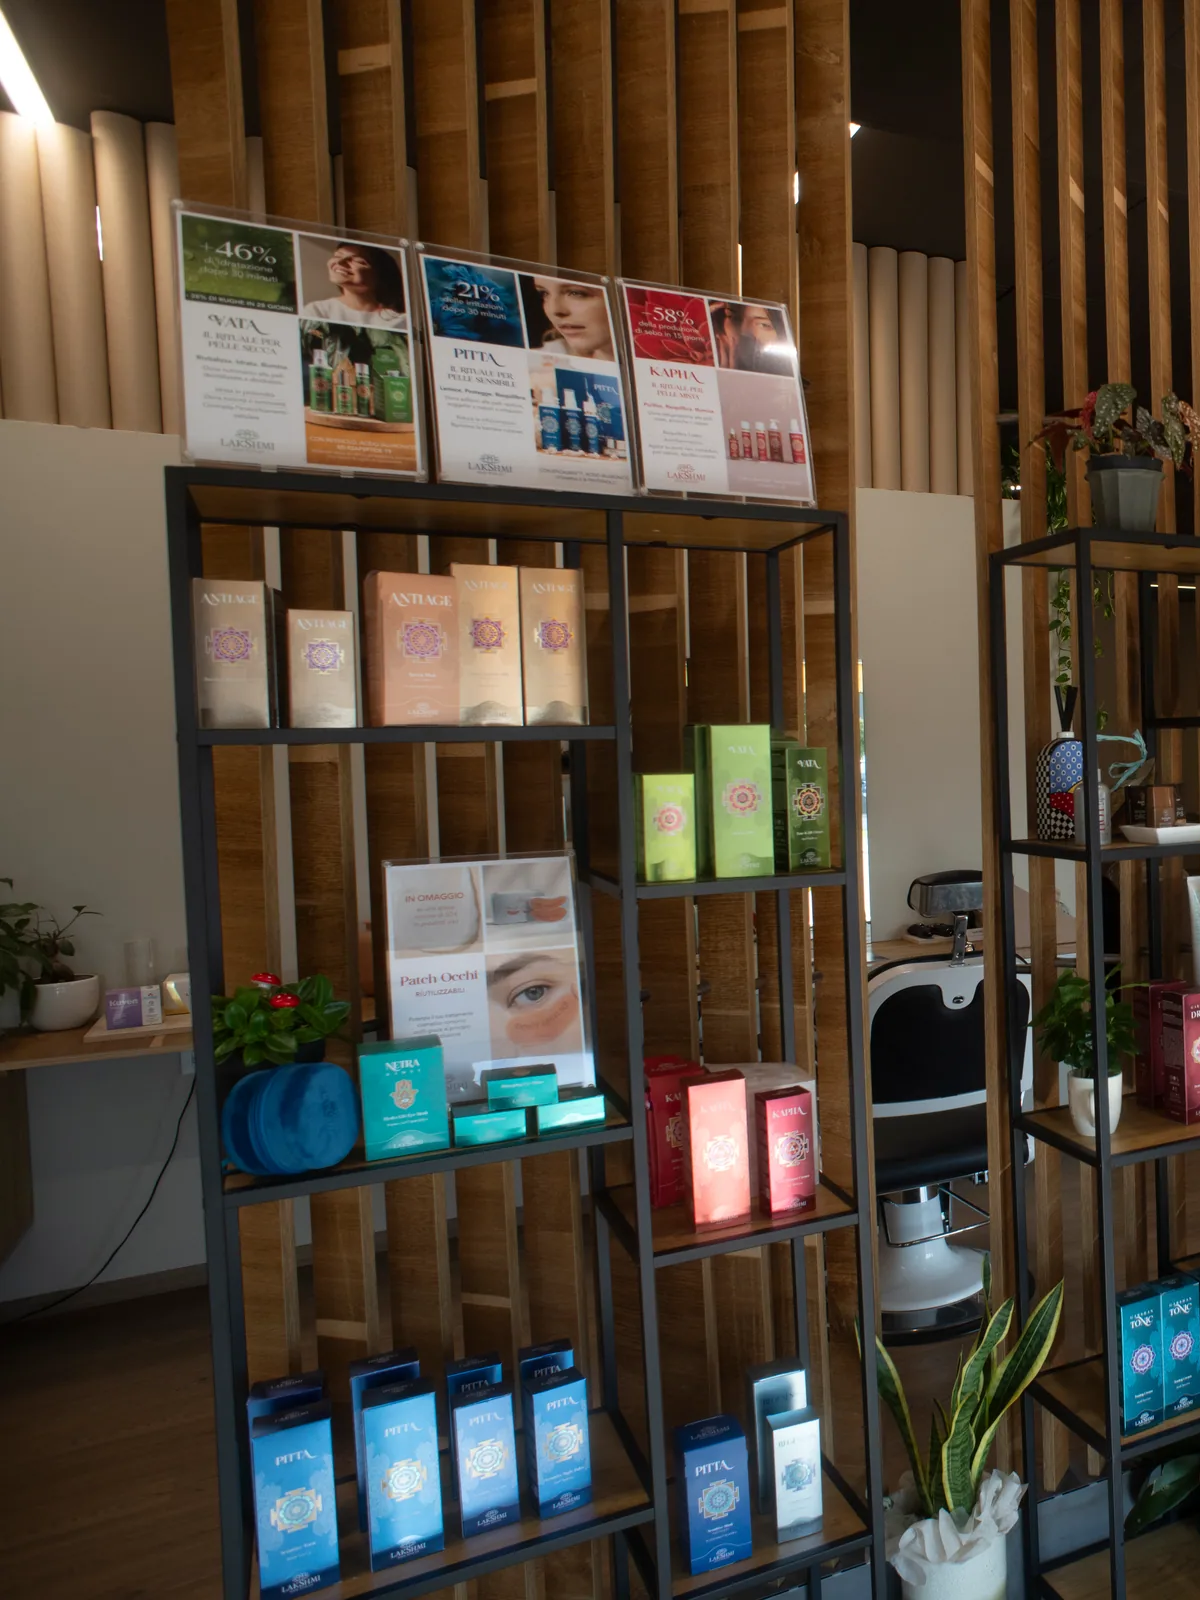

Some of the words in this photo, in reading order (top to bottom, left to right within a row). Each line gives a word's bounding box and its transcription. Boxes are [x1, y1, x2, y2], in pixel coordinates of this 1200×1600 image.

[207, 314, 270, 336] VATA
[454, 348, 506, 368] PITTA
[650, 366, 705, 385] KAPHA
[220, 438, 275, 451] LAKSHMI
[467, 462, 513, 474] LAKSHMI
[667, 471, 706, 481] LAKSHMI
[390, 592, 453, 607] ANTIAGE
[797, 759, 822, 769] VATA
[405, 895, 415, 903] IN
[417, 892, 464, 902] OMAGGIO
[400, 973, 438, 987] Patch
[441, 970, 479, 983] Occhi
[415, 988, 465, 997] RIUTILIZZABILI
[385, 1058, 420, 1072] NETRA
[771, 1105, 807, 1119] KAPHA
[1169, 1302, 1193, 1317] TONIC
[1130, 1315, 1154, 1329] TONIC
[534, 1364, 562, 1378] PITTA
[461, 1379, 490, 1393] PITTA
[546, 1396, 580, 1411] PITTA
[469, 1412, 504, 1427] PITTA
[384, 1422, 423, 1438] PITTA
[274, 1449, 319, 1467] PITTA
[695, 1459, 736, 1477] PITTA
[552, 1494, 581, 1509] LAKSHMI
[477, 1512, 507, 1526] LAKSHMI
[390, 1542, 427, 1559] LAKSHMI
[281, 1574, 321, 1593] LAKSHMI
